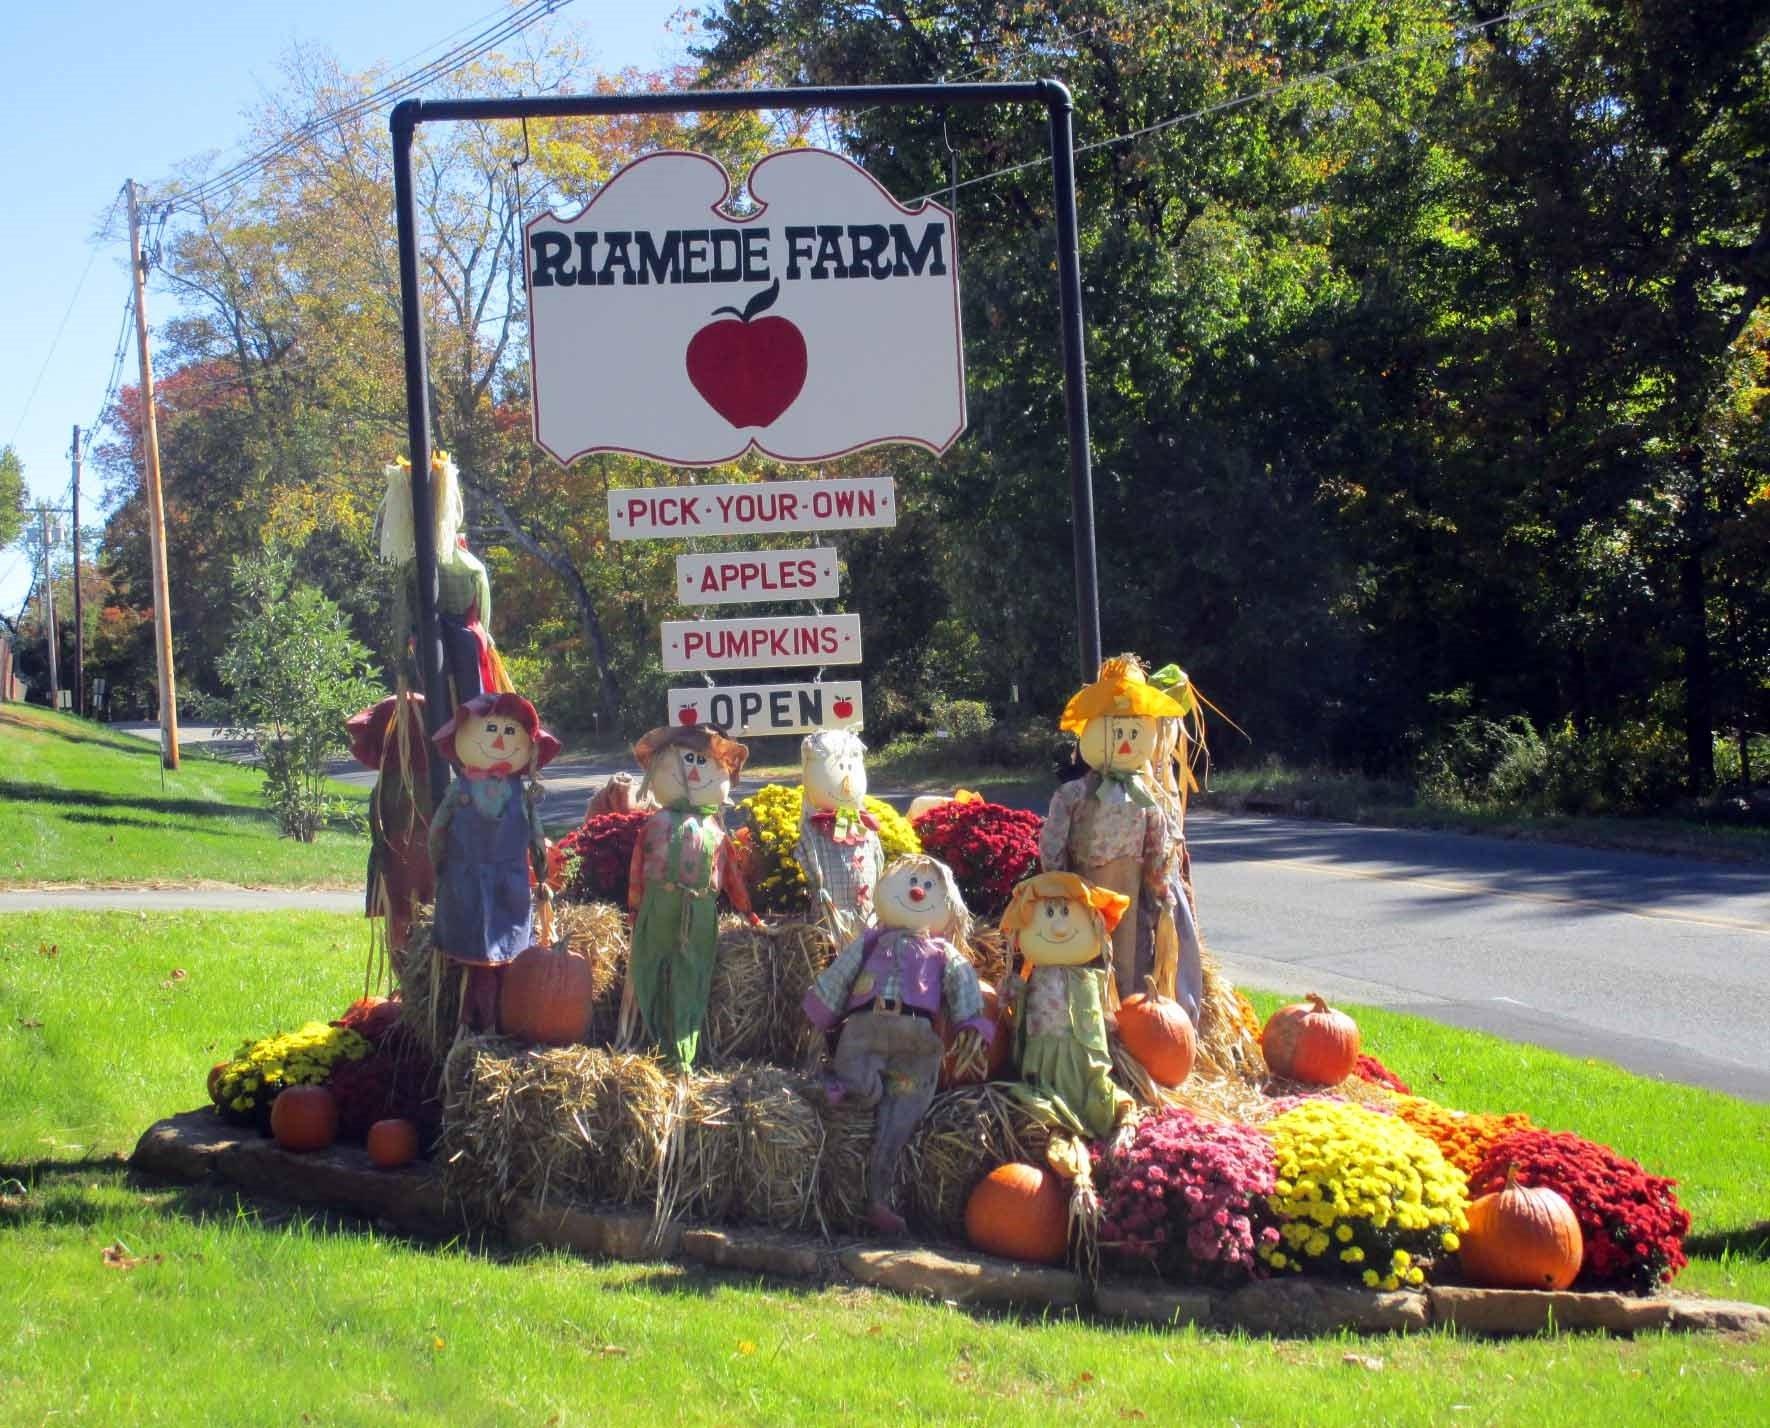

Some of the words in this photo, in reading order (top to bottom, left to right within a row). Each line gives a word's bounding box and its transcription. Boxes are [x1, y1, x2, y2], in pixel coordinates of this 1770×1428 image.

[530, 227, 771, 287] RIAMEDE
[785, 222, 947, 280] FARM
[627, 497, 701, 527] PICK
[716, 493, 798, 523] YOUR
[812, 489, 876, 518] OWN
[700, 560, 817, 593] APPLES
[683, 626, 839, 660] PUMPKINS
[710, 688, 824, 729] OPEN
